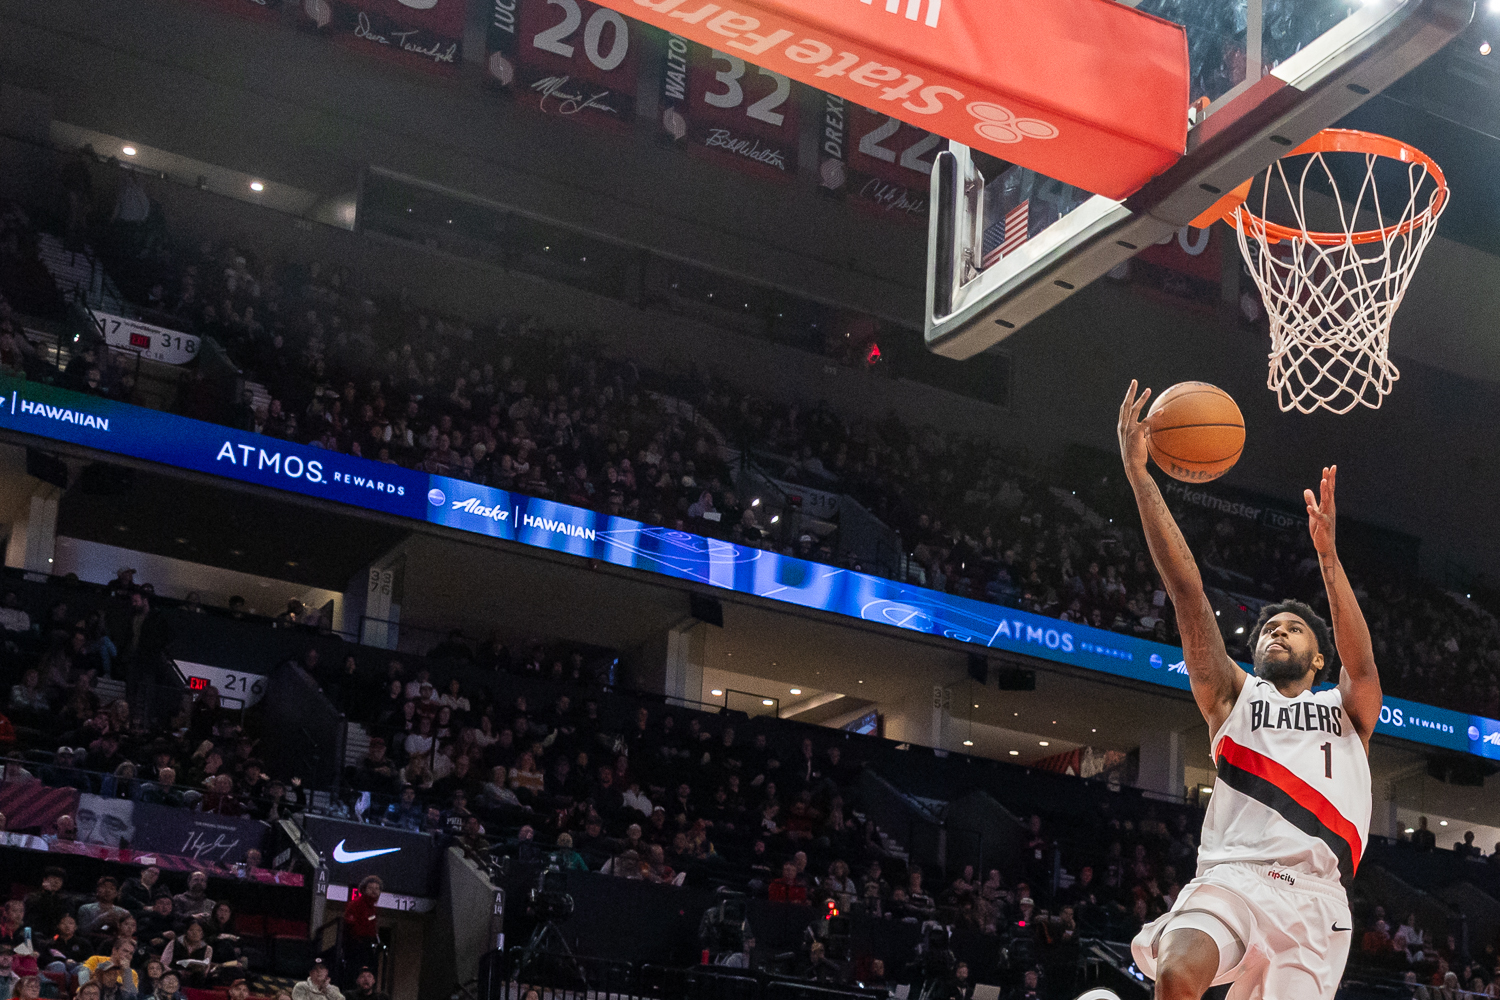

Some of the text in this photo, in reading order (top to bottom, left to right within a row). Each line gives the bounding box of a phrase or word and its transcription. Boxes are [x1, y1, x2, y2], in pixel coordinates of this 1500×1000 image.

[532, 0, 629, 71] 20
[704, 48, 791, 127] 32
[161, 334, 196, 353] 318
[21, 400, 109, 431] HAWAIIAN
[216, 440, 597, 542] ATMOS REWARDS Alaska HAWAIIAN
[224, 674, 263, 694] 216
[1250, 700, 1342, 737] BLAZERS
[1409, 716, 1454, 734] REWARDS
[1320, 741, 1332, 779] 1
